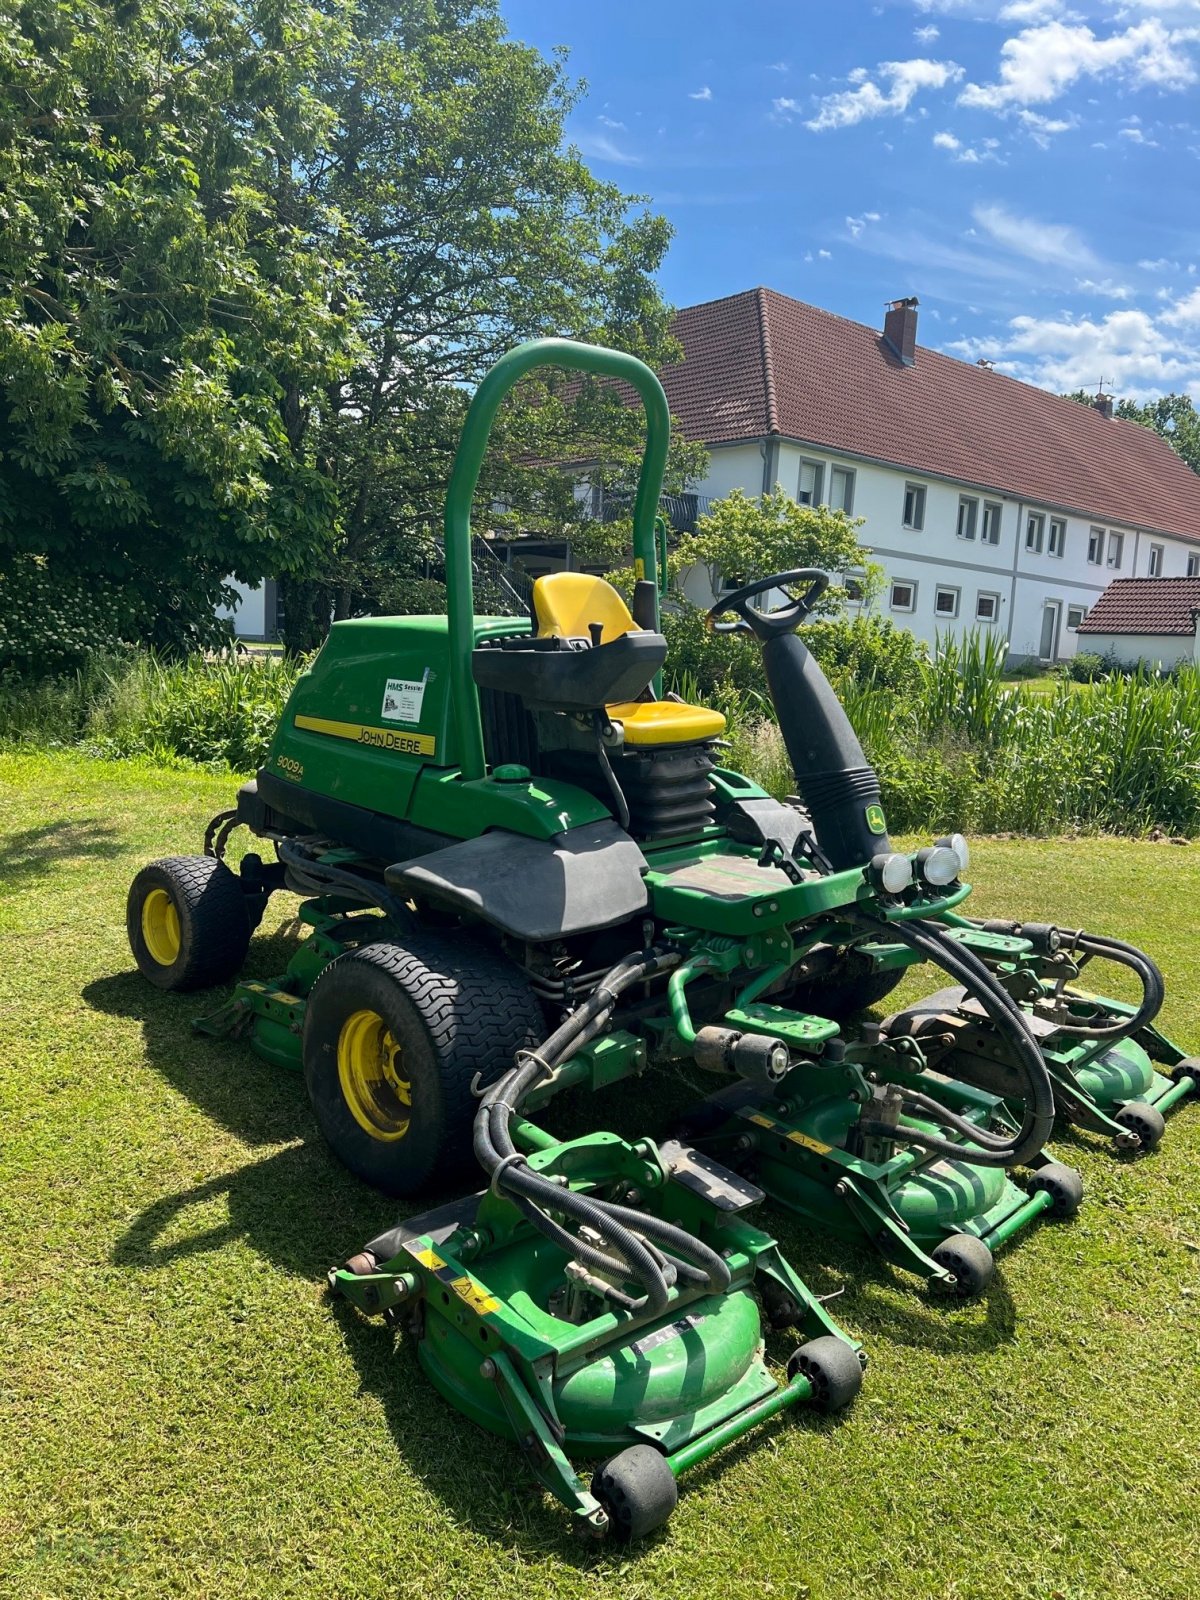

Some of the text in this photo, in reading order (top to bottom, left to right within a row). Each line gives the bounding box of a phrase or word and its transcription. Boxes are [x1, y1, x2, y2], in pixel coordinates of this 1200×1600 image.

[387, 683, 403, 692] HMS
[358, 728, 421, 753] JOHN DEERE
